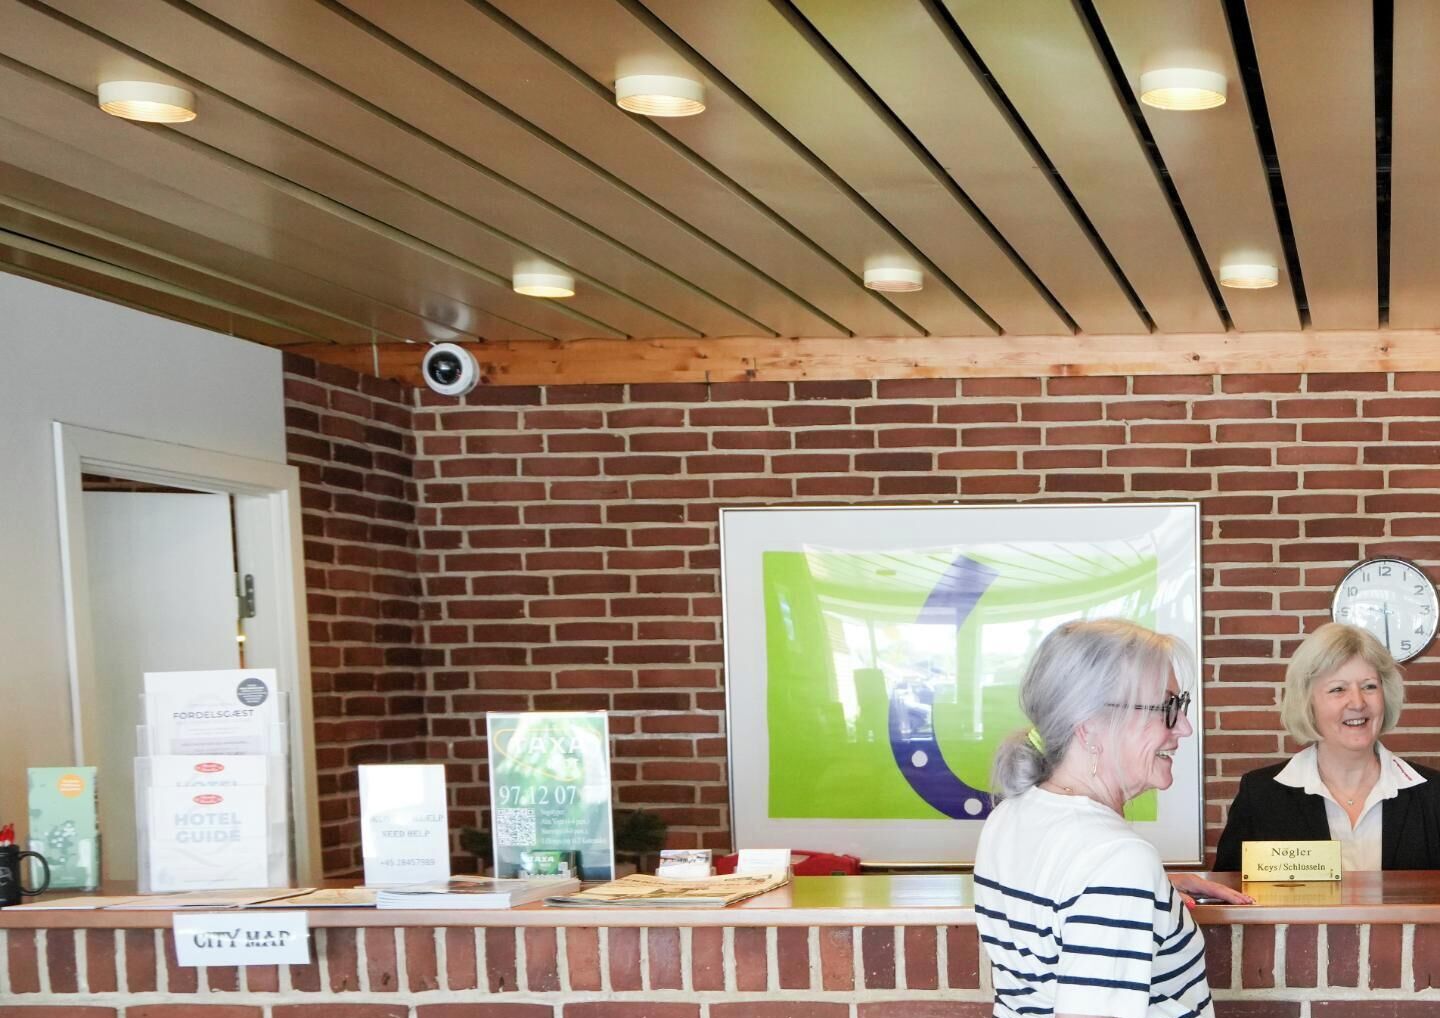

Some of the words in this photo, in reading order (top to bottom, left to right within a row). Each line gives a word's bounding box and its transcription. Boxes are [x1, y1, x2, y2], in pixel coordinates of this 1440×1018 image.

[1362, 572, 1370, 582] 11
[1378, 566, 1392, 577] 12
[1347, 586, 1359, 598] 10
[1413, 585, 1425, 596] 2
[1419, 605, 1431, 616] 3
[1414, 624, 1425, 636] 4
[1400, 639, 1412, 651] 5
[172, 708, 255, 720] FORDELSGÆST
[499, 785, 521, 805] 97
[529, 785, 550, 805] 12
[554, 785, 577, 805] 07
[175, 811, 242, 827] HOTEL
[175, 829, 241, 844] GUIDE
[1271, 847, 1313, 859] Nøgler
[193, 927, 241, 949] CITY
